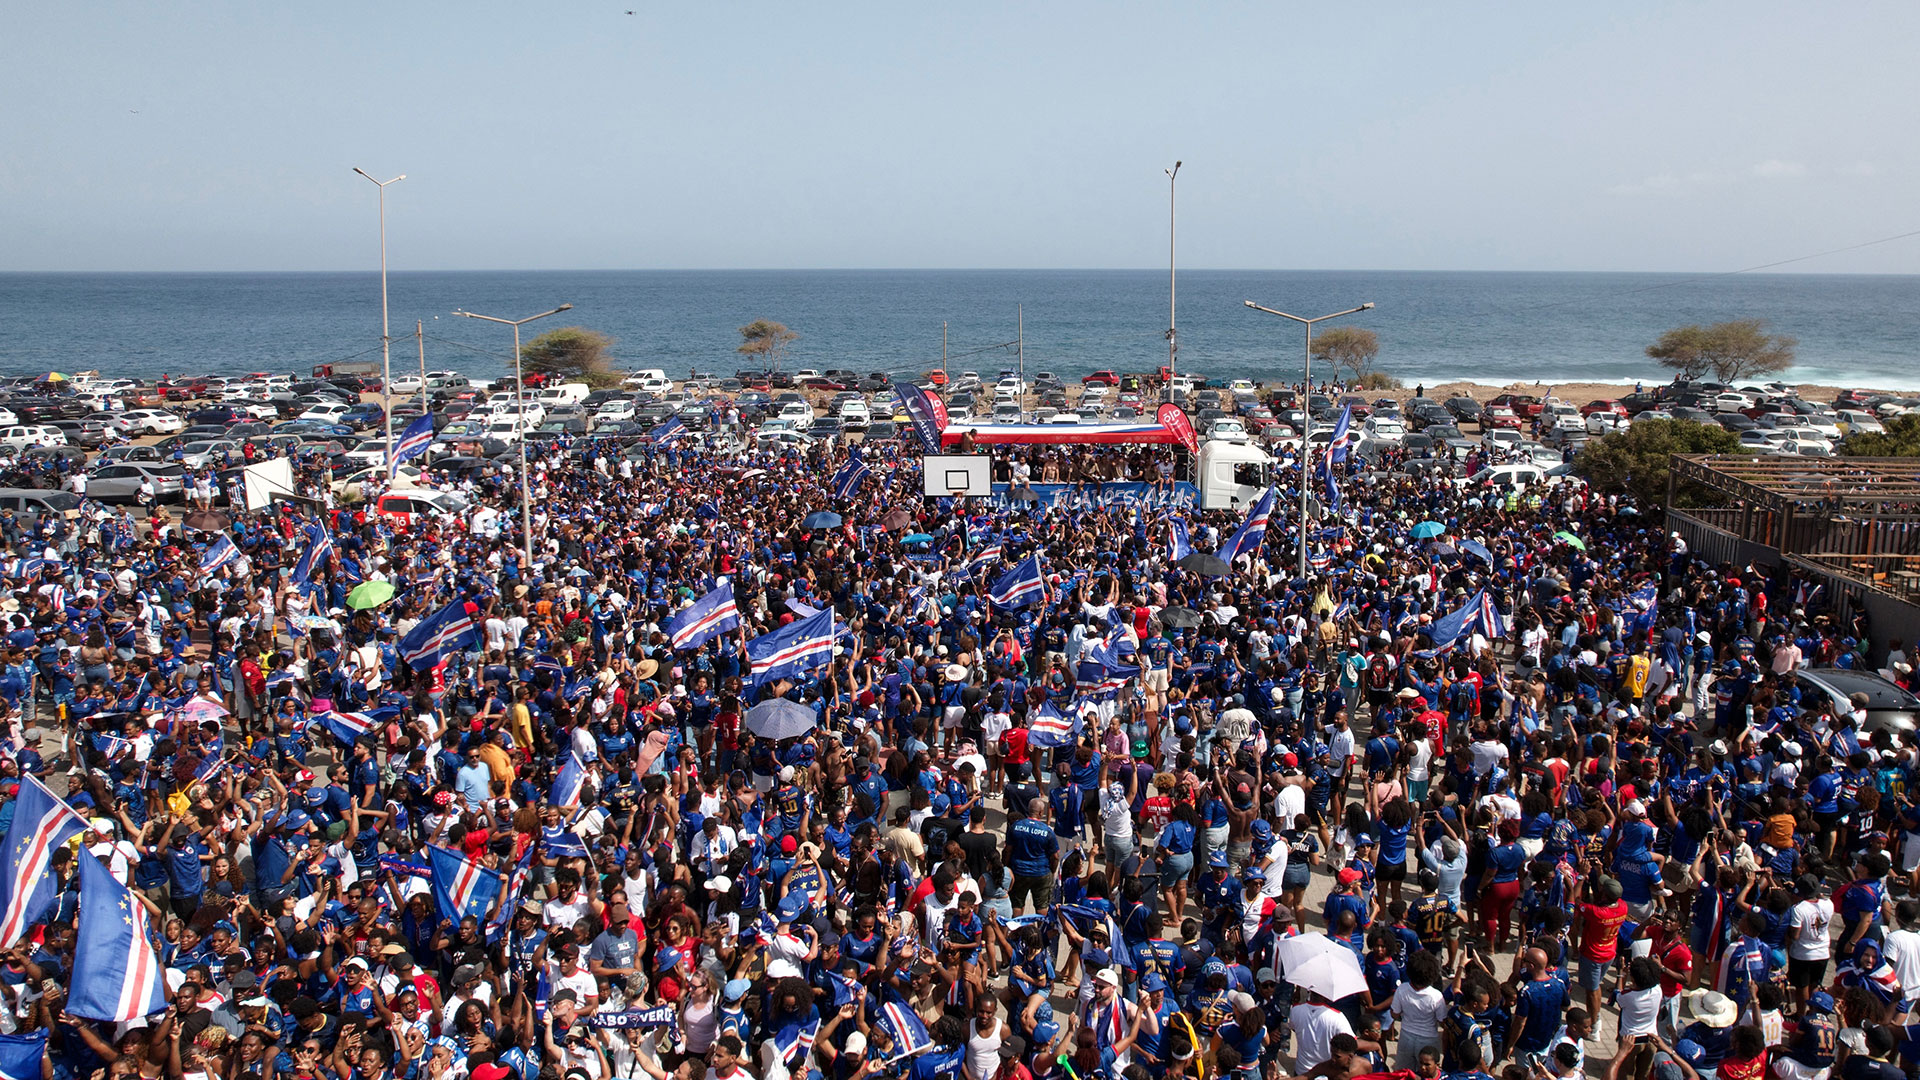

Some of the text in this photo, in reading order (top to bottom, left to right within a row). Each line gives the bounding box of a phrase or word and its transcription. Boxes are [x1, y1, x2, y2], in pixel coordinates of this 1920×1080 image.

[1636, 671, 1643, 682] 6
[1014, 825, 1049, 838] AICHA LOPES
[1860, 815, 1873, 832] 10
[1423, 911, 1445, 933] 10
[1765, 1022, 1780, 1041] 10
